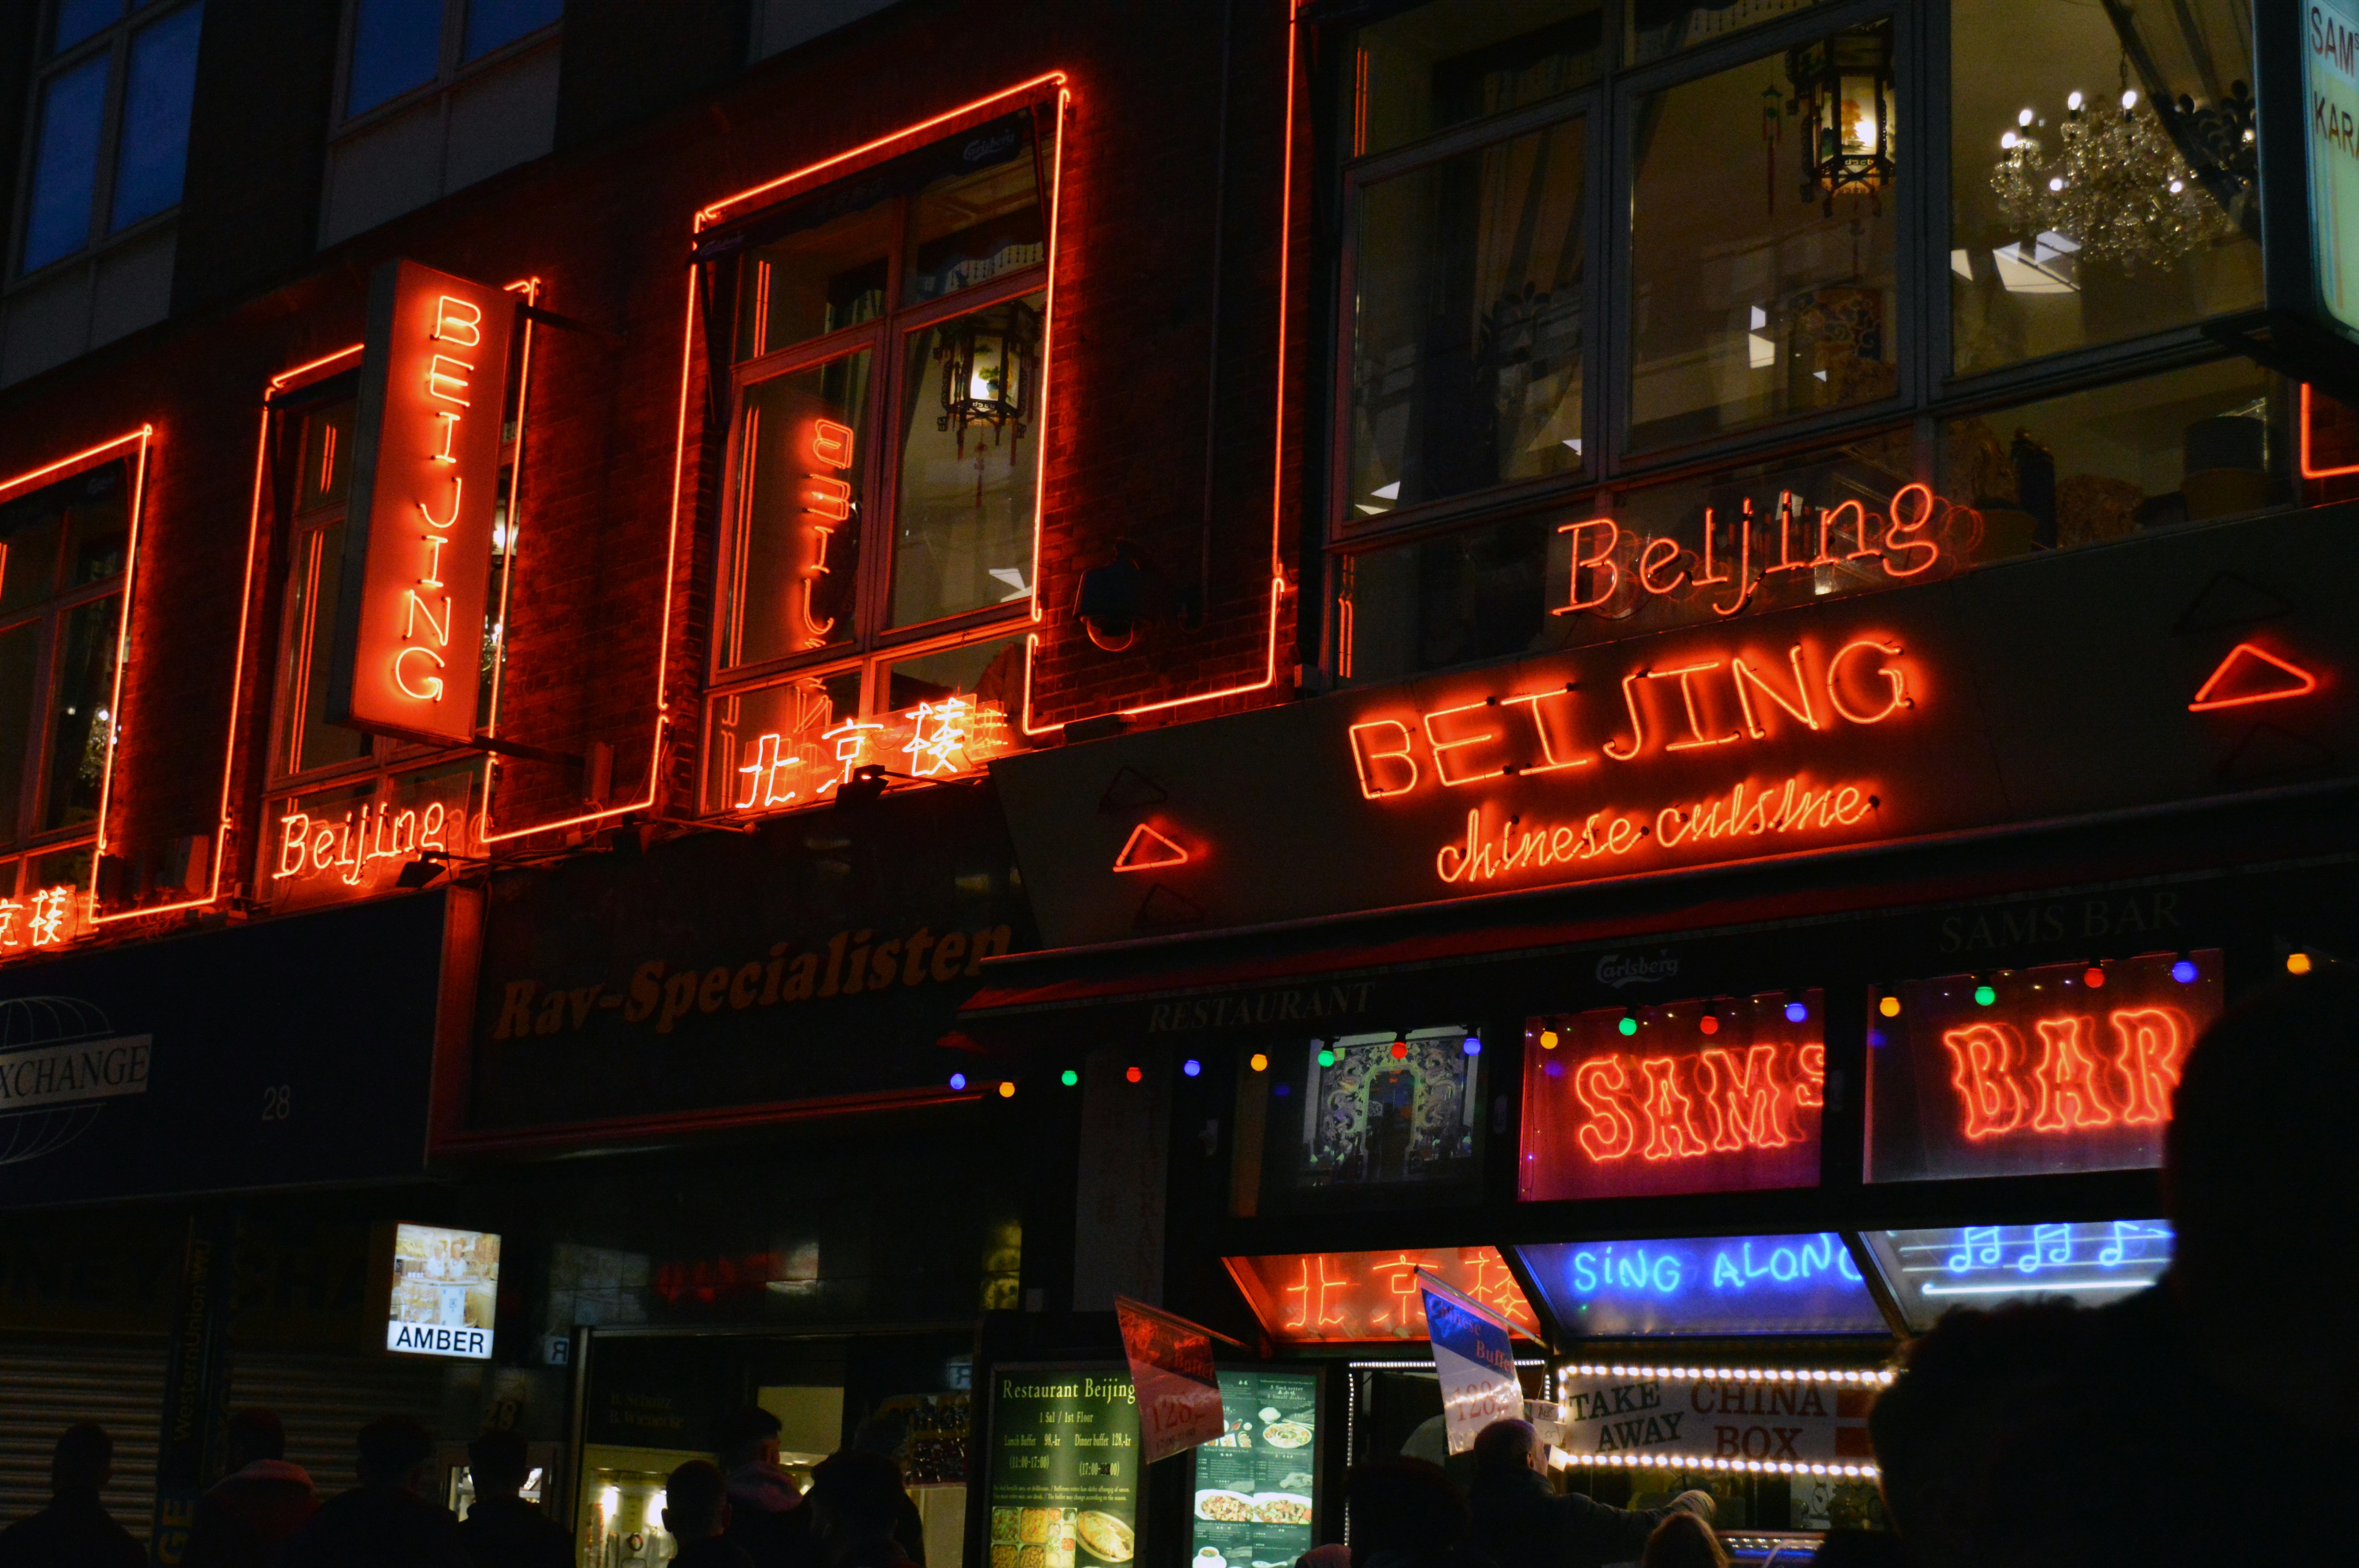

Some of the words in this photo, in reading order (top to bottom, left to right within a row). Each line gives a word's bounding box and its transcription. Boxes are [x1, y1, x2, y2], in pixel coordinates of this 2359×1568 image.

[2314, 91, 2359, 160] KAR
[395, 295, 482, 703] BEIJING
[1549, 483, 1940, 617] Beijing
[1348, 640, 1913, 801] BEIJING
[272, 802, 444, 886] Beijing
[1939, 905, 2066, 955] SAMS
[2082, 891, 2182, 940] BAR
[493, 924, 1012, 1041] Rav-Specialisten
[1595, 949, 1679, 989] Carlsberg
[1148, 981, 1377, 1033] RESTAURANT
[1942, 1008, 2180, 1140] BAR
[261, 1084, 291, 1122] 28
[396, 1326, 484, 1354] AMBER
[1002, 1379, 1079, 1399] Restaurant
[1084, 1377, 1136, 1405] Beijing
[1569, 1379, 1661, 1421] TAKE
[1690, 1380, 1828, 1417] CHINA
[1076, 1411, 1094, 1424] Floor
[1596, 1411, 1685, 1454] AWAY
[1713, 1425, 1803, 1460] BOX
